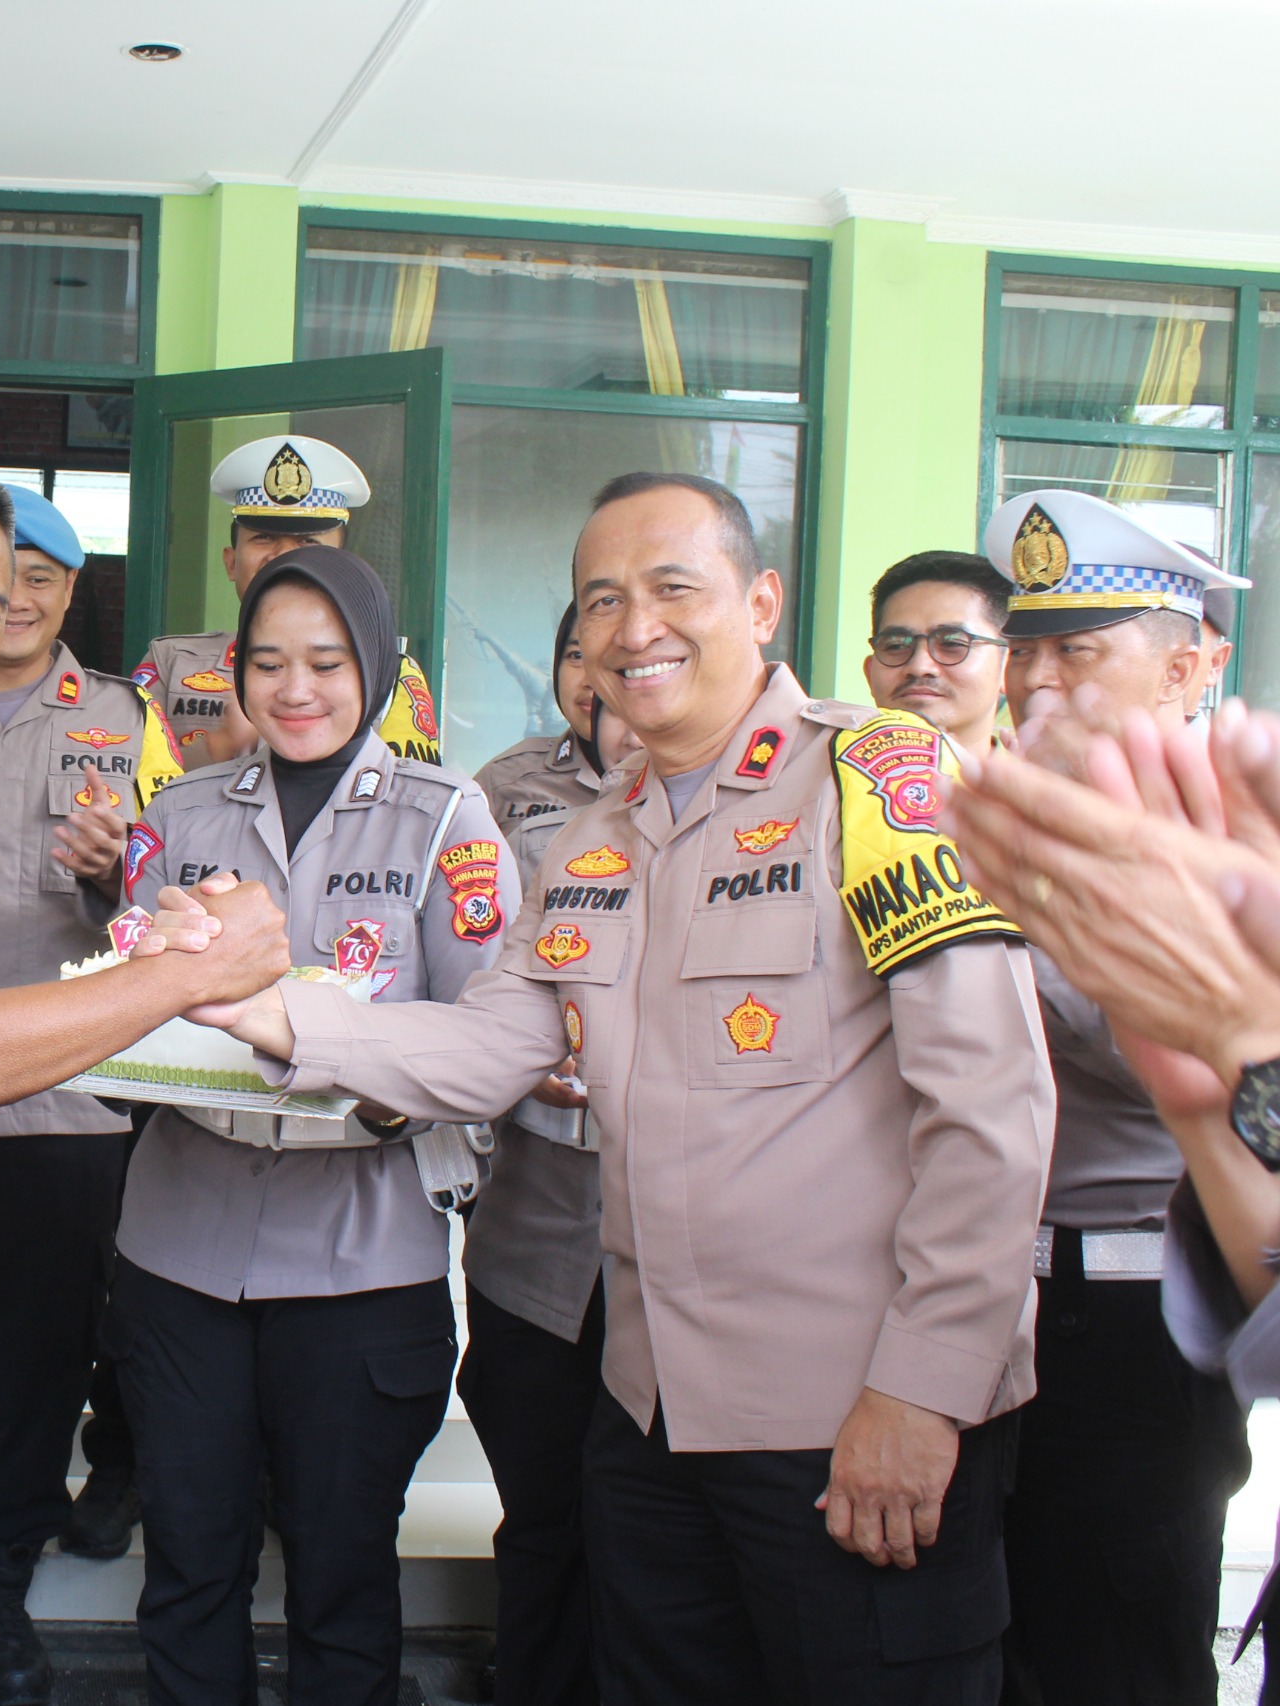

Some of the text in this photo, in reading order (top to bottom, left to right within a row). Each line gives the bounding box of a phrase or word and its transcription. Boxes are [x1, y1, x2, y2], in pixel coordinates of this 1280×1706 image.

[173, 698, 224, 717] ASEN
[853, 730, 933, 758] POLRES
[864, 739, 928, 760] MAJALENGKA
[61, 754, 132, 776] POLRI
[877, 755, 930, 774] JAWA BARAT
[439, 843, 497, 865] POLRES
[445, 851, 496, 871] MAJALENGKA
[326, 869, 414, 898] POLRI
[707, 861, 801, 904] POLRI
[558, 928, 573, 936] SAR
[868, 932, 892, 959] OPS
[890, 905, 944, 943] MANTAP
